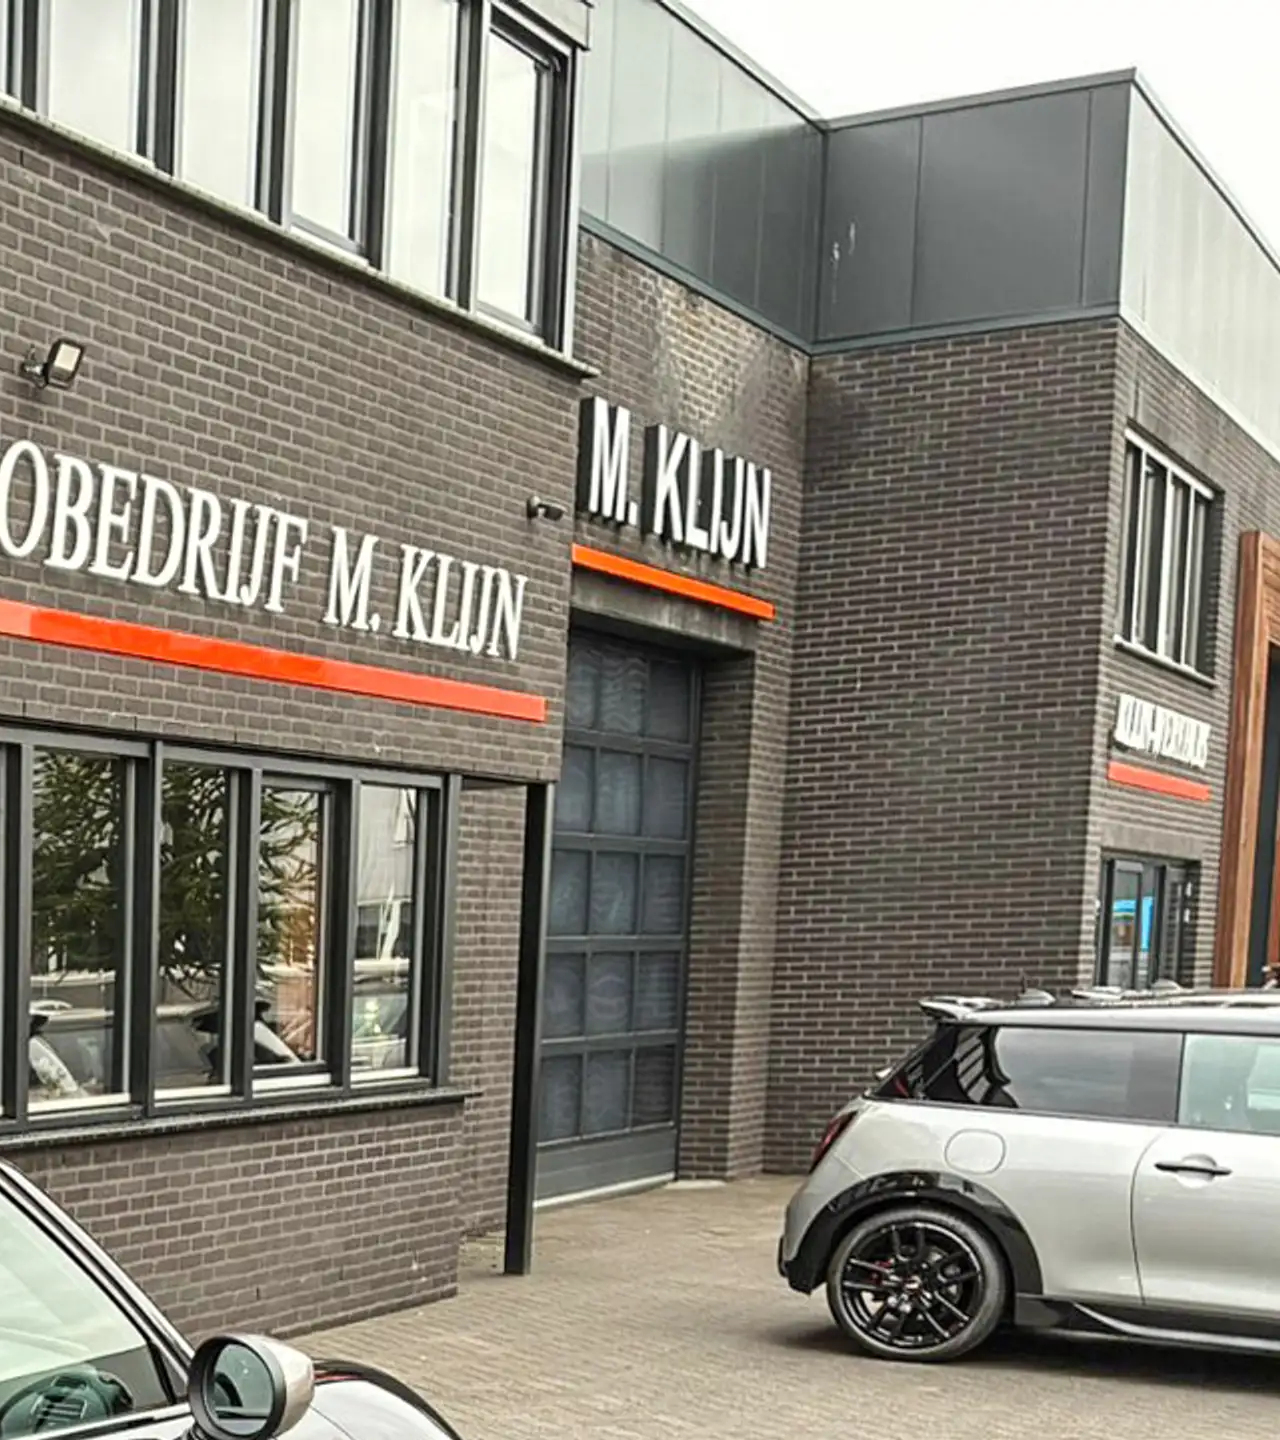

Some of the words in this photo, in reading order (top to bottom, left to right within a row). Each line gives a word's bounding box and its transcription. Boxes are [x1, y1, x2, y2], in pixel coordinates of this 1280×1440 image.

[587, 395, 638, 527] M.
[652, 423, 772, 569] KLIJN
[322, 525, 381, 632] M.
[391, 543, 529, 661] KLIJN
